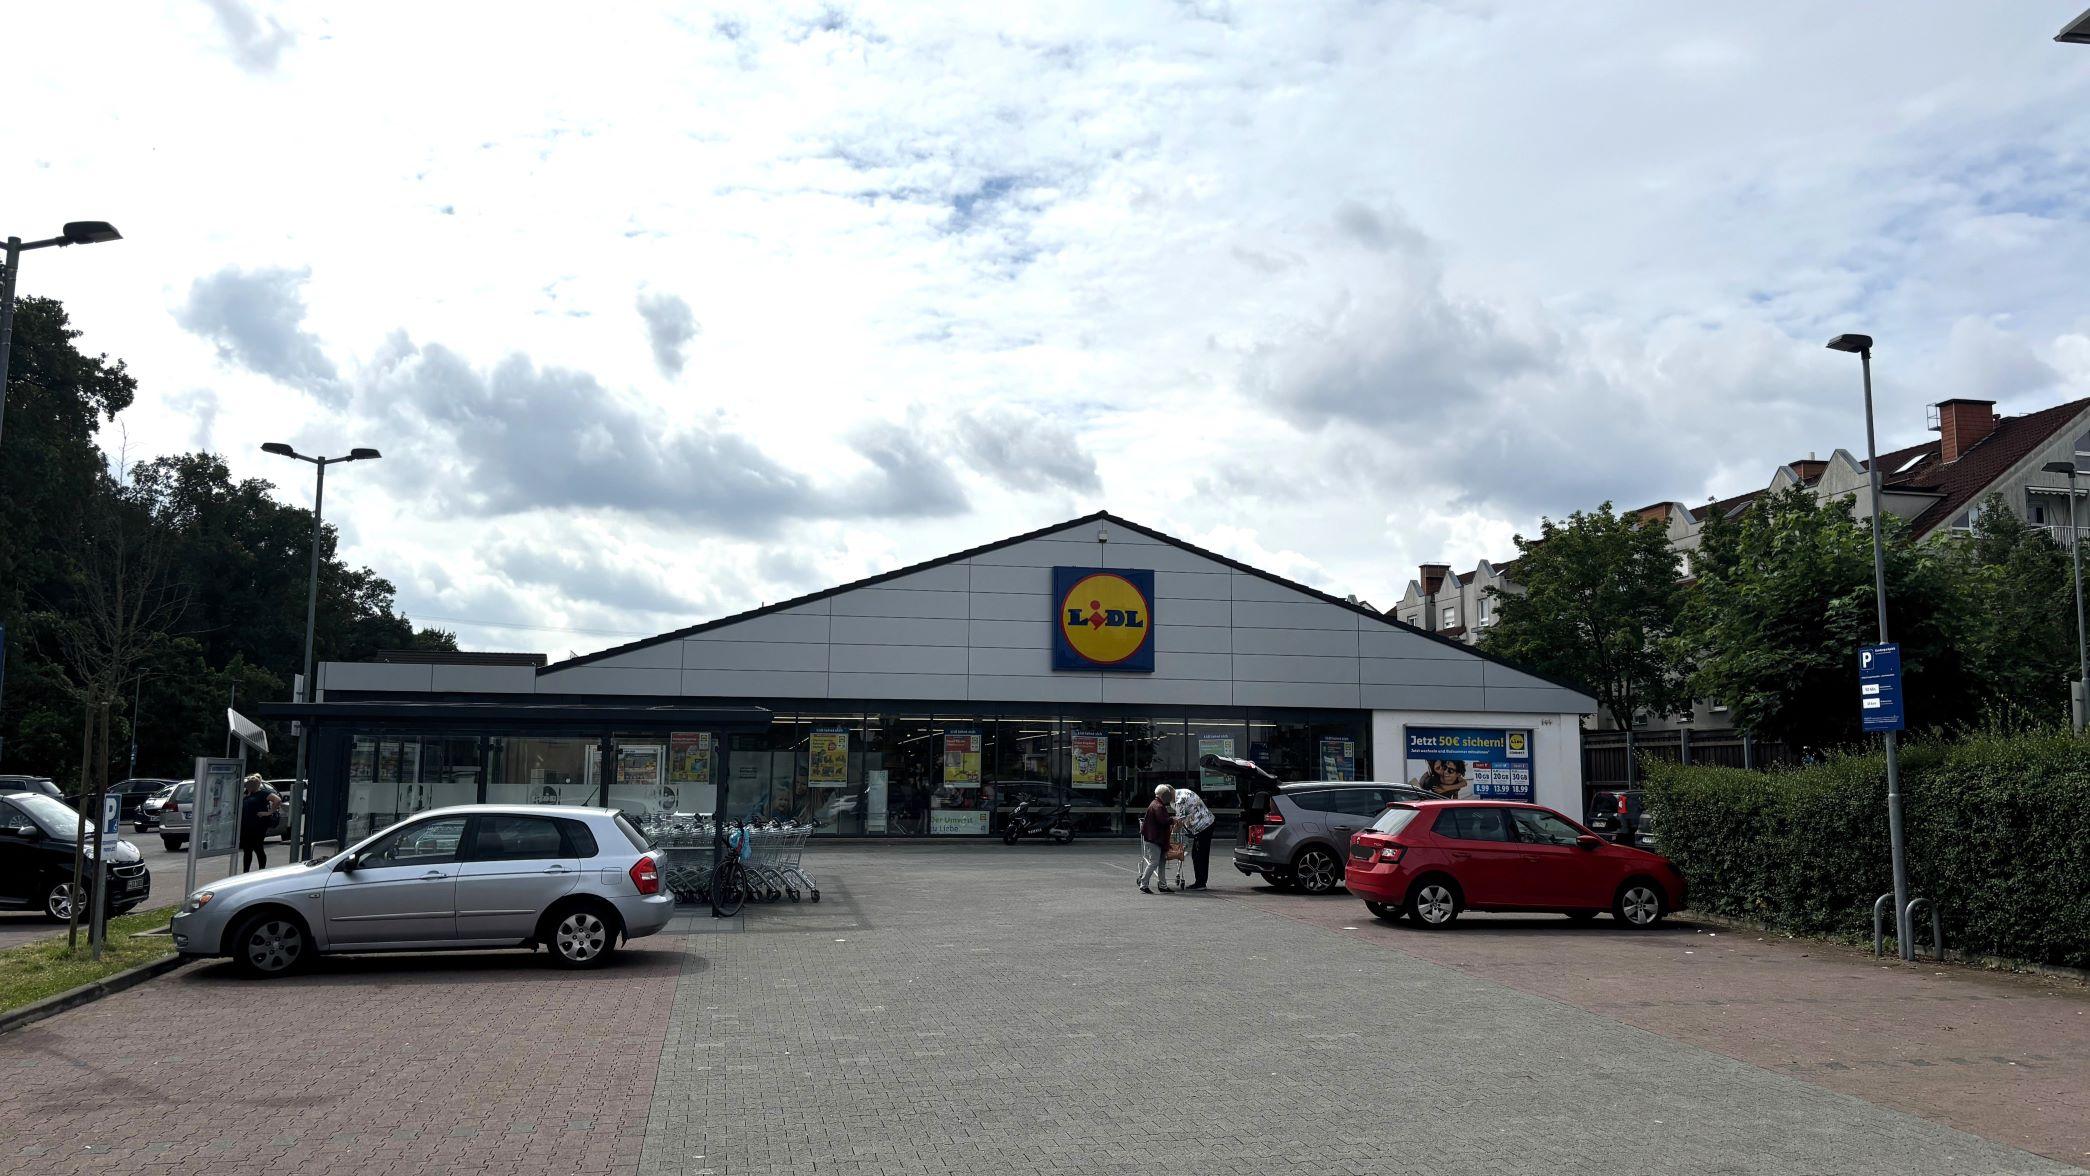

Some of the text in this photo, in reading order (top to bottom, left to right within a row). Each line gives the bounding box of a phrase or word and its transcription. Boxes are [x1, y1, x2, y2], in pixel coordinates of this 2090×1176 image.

[1862, 651, 1872, 668] P
[1410, 735, 1504, 747] Jetzt 50€ sichern!
[104, 798, 117, 833] P
